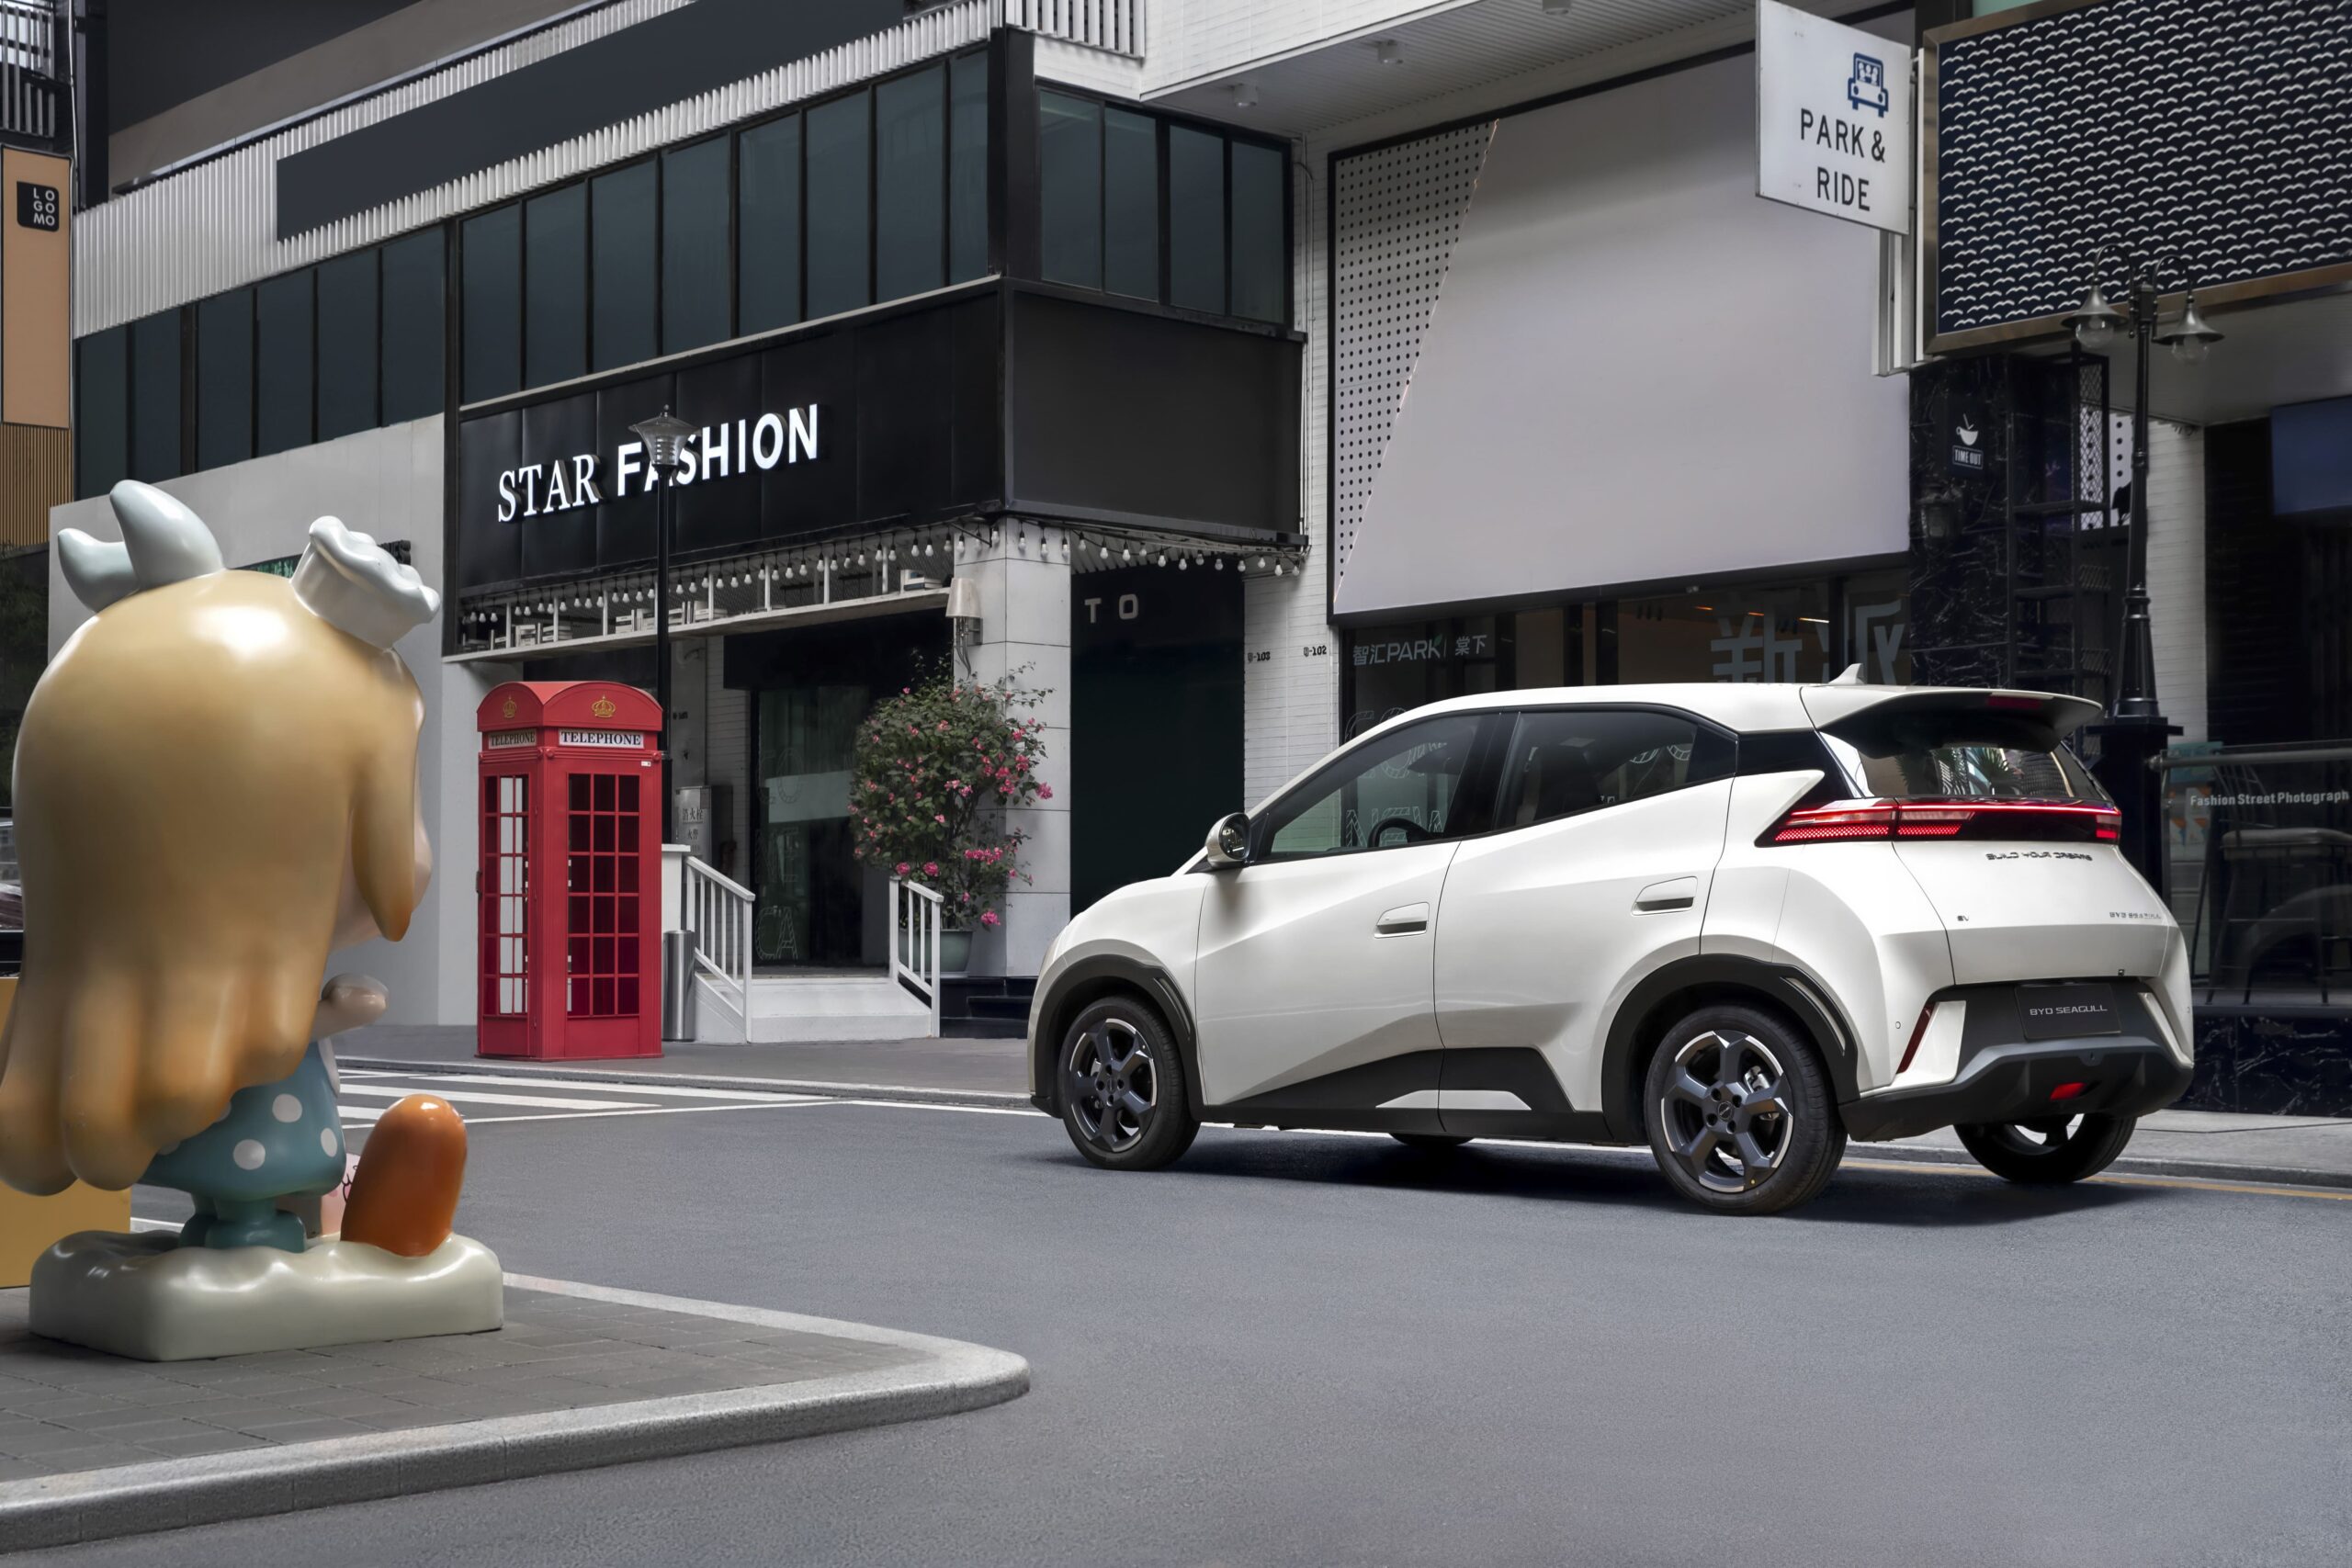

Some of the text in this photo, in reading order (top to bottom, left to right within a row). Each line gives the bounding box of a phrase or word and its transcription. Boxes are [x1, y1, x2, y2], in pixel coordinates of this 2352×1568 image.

[1800, 107, 1886, 164] PARK &
[1816, 165, 1871, 212] RIDE
[497, 453, 600, 523] STAR
[490, 733, 536, 746] TELEPHONE
[560, 730, 641, 746] TELEPHONE
[2189, 789, 2350, 807] Fashion Street Photograph
[2029, 1004, 2109, 1016] BYD SEAGULL
